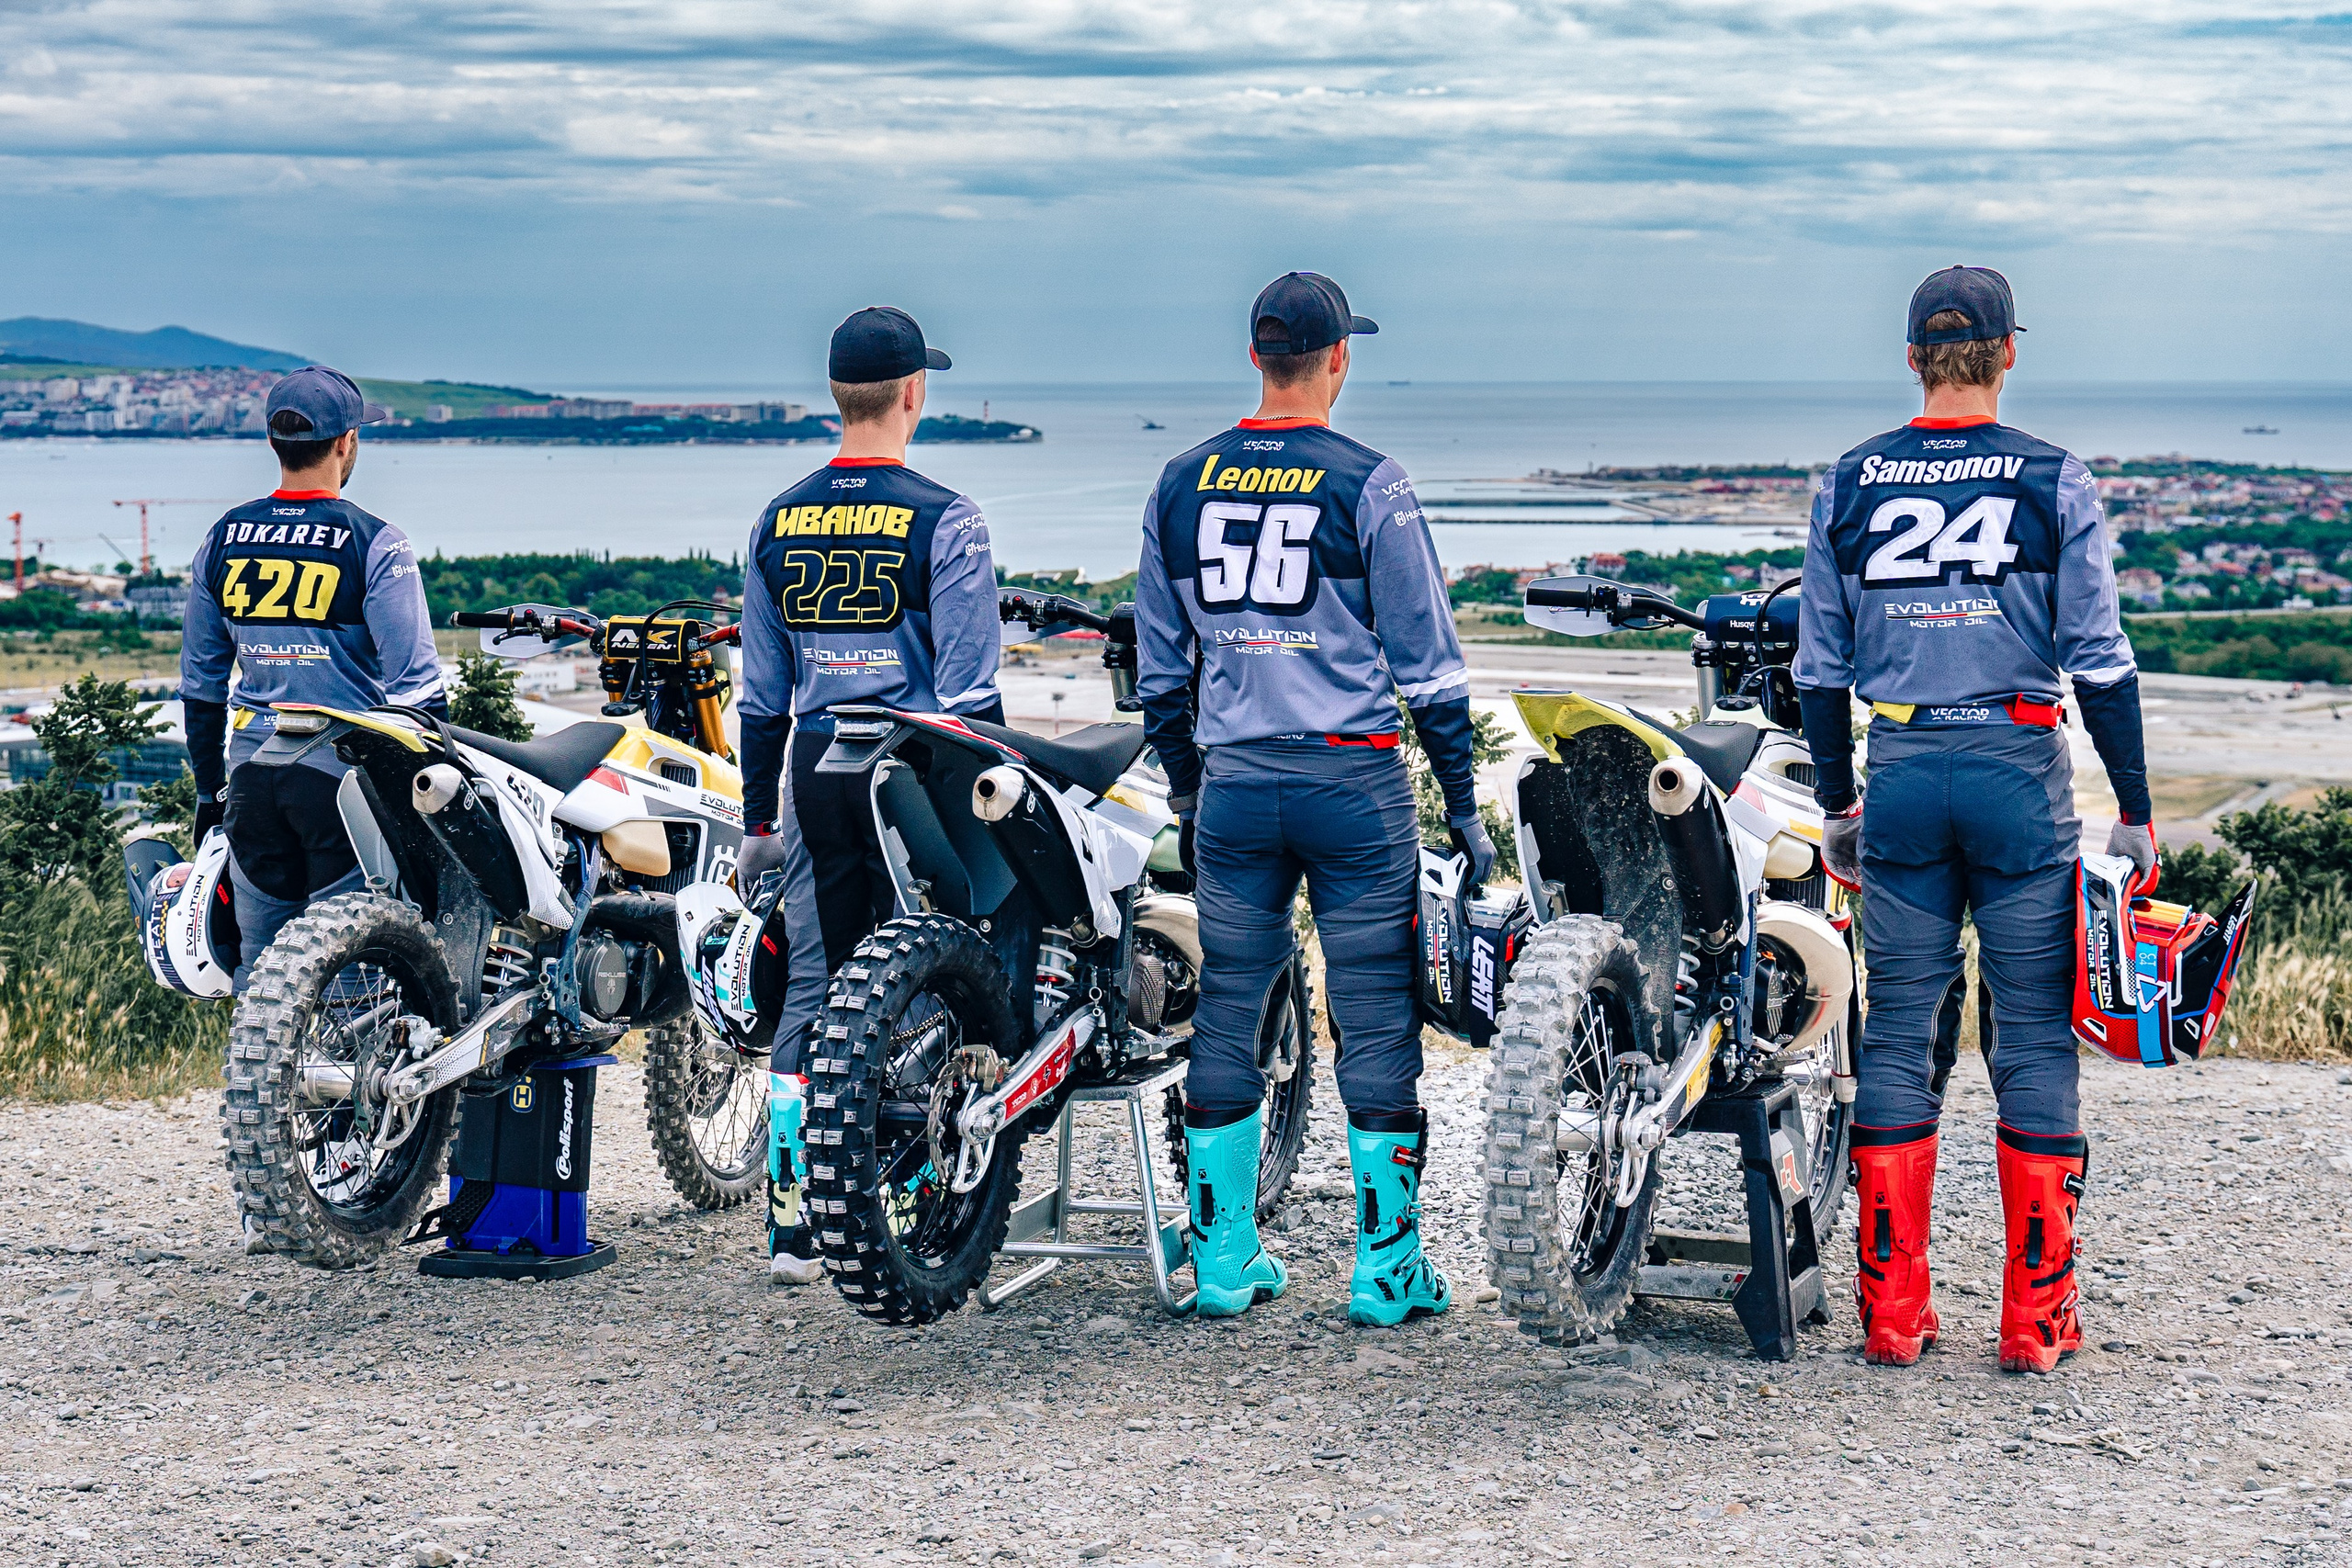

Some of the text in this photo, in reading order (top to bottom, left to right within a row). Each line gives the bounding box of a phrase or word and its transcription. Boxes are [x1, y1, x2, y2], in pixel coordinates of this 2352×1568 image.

[1196, 454, 1326, 493] Leonov
[1859, 455, 2024, 487] Samsonov
[223, 523, 352, 549] BOKAREV
[775, 504, 914, 538] ИВАНОВ
[1864, 496, 2019, 581] 24
[1197, 501, 1321, 604] 56
[222, 558, 341, 621] 420
[783, 549, 906, 624] 225
[1215, 627, 1317, 643] EVOLUTION
[1730, 620, 1769, 628] Husqvaa
[1909, 617, 1988, 628] MOTOR OIL
[239, 643, 330, 656] EVOLUTION
[803, 648, 899, 660] EVOLUTION
[1235, 646, 1300, 657] MOTOR OIL
[816, 667, 881, 675] MOTOR OIL
[1930, 707, 1990, 717] VECTOR
[151, 901, 164, 961] LEATT
[186, 874, 205, 956] EVOLUTION
[2222, 914, 2238, 946] LEATT
[1439, 900, 1453, 1003] EVOLUTION
[2086, 928, 2096, 968] MOTOR
[2098, 909, 2114, 1009] EVOLUTION
[2146, 953, 2156, 967] CT
[731, 924, 751, 1011] EVOLUTION
[1472, 935, 1494, 1021] LEATT
[556, 1077, 574, 1180] Polisport
